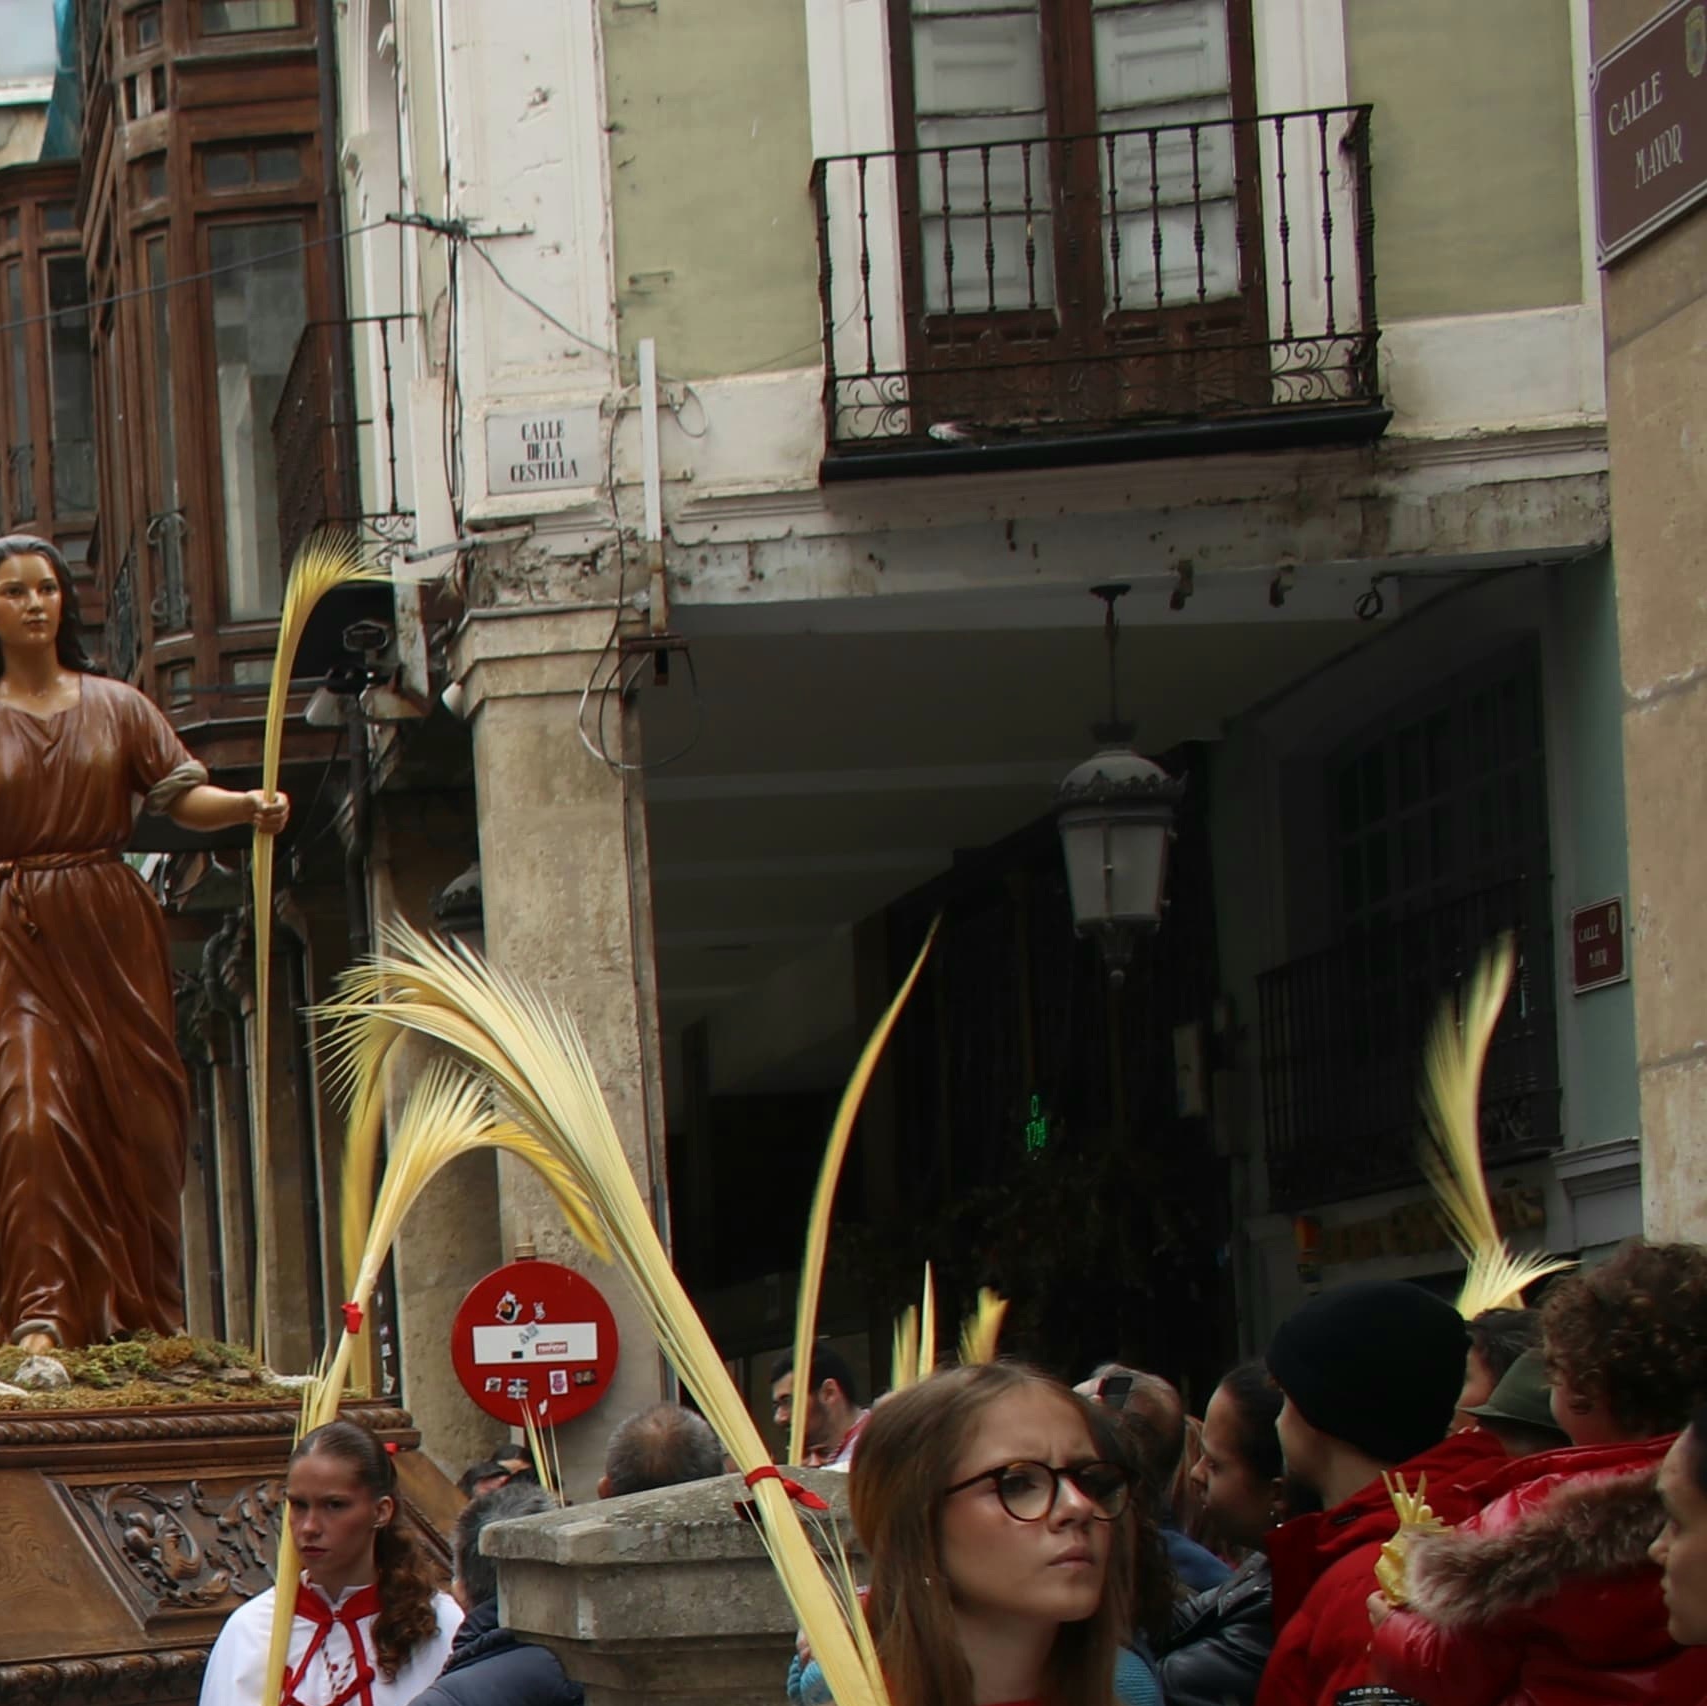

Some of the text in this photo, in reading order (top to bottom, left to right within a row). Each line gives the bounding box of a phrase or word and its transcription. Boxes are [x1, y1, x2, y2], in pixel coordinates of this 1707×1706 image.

[1608, 71, 1663, 136] CALLE
[1634, 123, 1683, 189] MAYOR
[521, 419, 566, 442] CALLE
[527, 440, 563, 461] DE LA
[509, 458, 578, 482] CESTILLA
